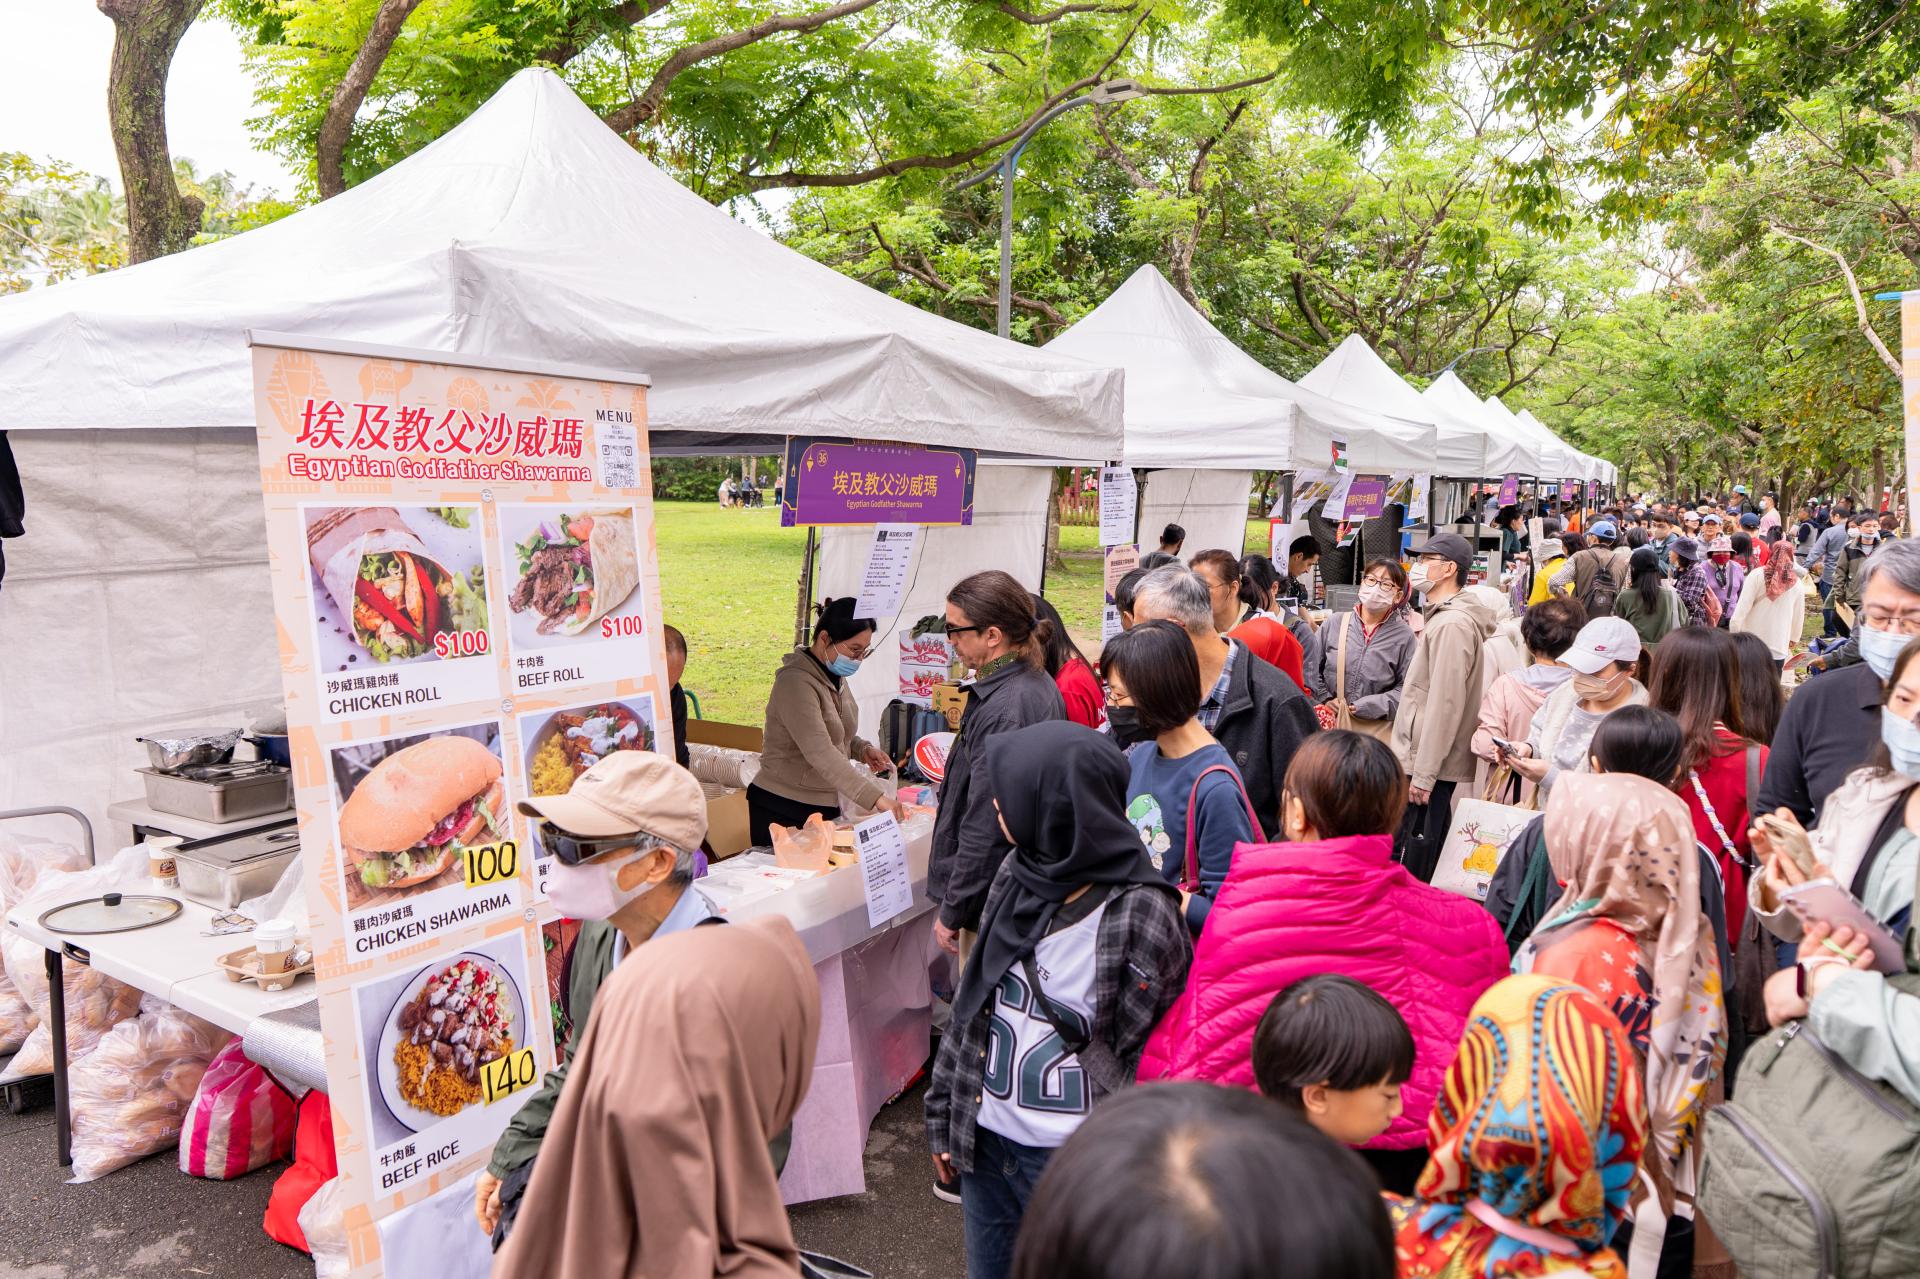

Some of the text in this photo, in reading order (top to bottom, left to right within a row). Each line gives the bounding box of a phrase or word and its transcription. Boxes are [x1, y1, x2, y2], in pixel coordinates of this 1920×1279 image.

[296, 399, 584, 458] 埃及教父沙威瑪
[596, 409, 633, 423] MENU
[288, 453, 592, 482] Egyptian Godfather Shawarma
[832, 470, 938, 497] 埃及教父沙威瑪
[846, 499, 923, 510] Egyptian Godfather Shawarma
[601, 616, 642, 640] $100
[434, 630, 488, 659] $100
[327, 673, 400, 694] 沙威瑪雞肉捲
[518, 667, 585, 688] BEEF ROLL
[329, 687, 442, 715] CHICKEN ROLL
[467, 841, 516, 882] 100
[353, 904, 414, 933] 雞肉沙威瑪
[355, 893, 512, 954] CHICKEN SHAWARMA
[487, 1051, 536, 1103] 140
[380, 1143, 416, 1168] 牛肉飯
[382, 1140, 460, 1189] BEEF RICE
